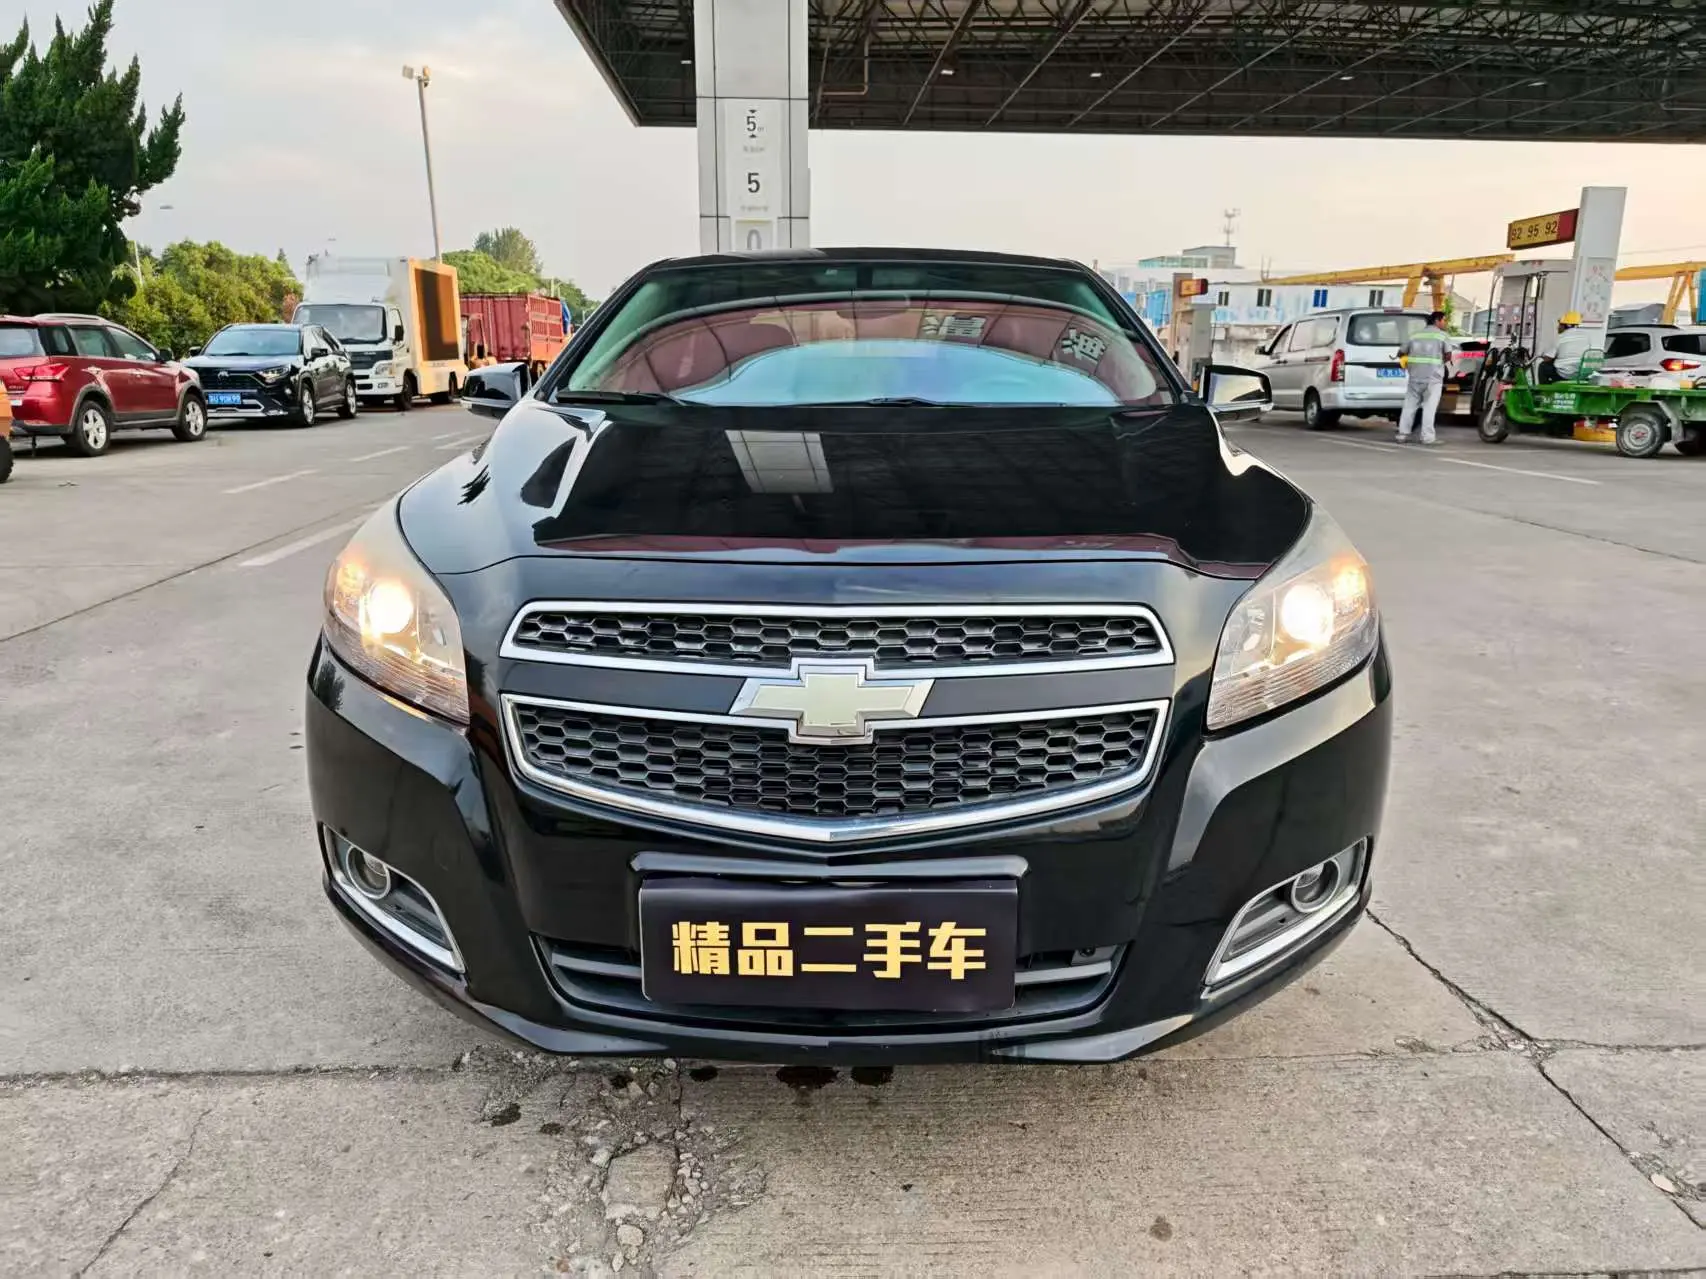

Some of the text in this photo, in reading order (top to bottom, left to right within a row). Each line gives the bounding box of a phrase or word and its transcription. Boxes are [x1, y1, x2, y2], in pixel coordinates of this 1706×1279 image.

[747, 172, 761, 194] 5
[1511, 220, 1558, 241] 92 95 92
[671, 920, 987, 980] 精品二手车
